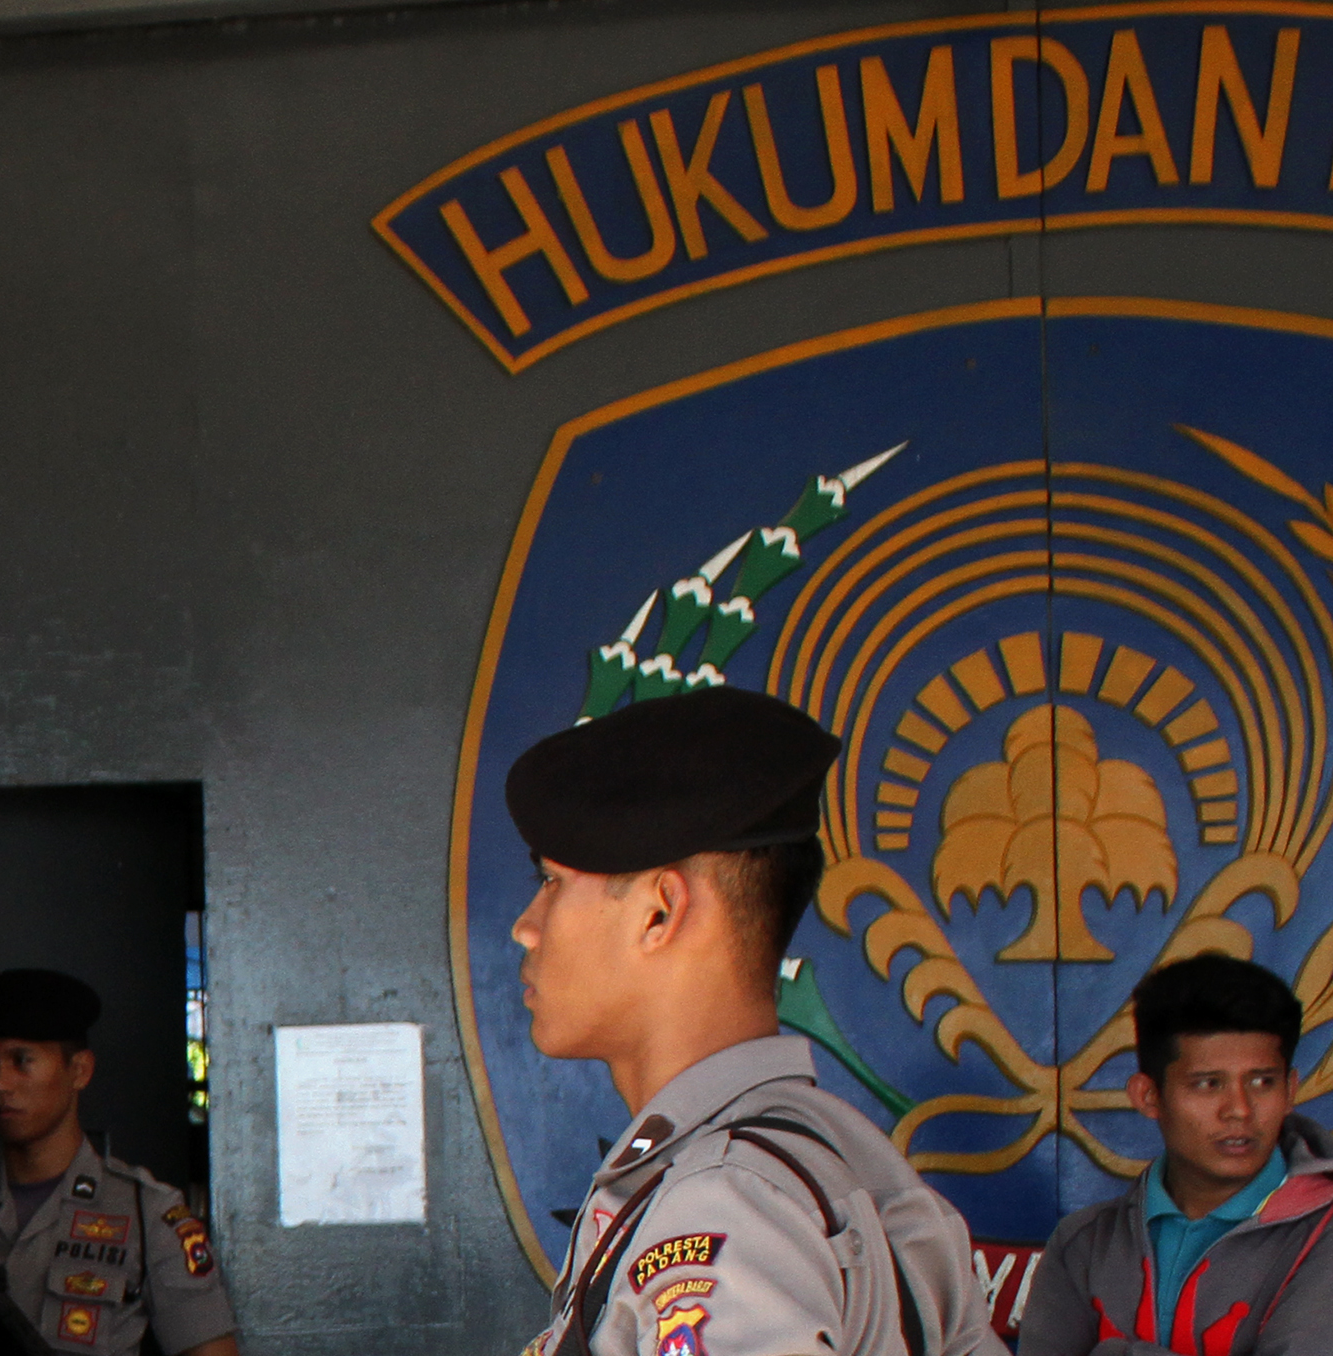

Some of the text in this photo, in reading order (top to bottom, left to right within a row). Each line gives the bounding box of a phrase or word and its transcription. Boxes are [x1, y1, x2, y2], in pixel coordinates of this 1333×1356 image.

[440, 25, 1301, 338] HUKUM DAN
[54, 1240, 128, 1266] POLISI
[636, 1250, 710, 1286] PADANG
[637, 1236, 711, 1272] POLRESTA
